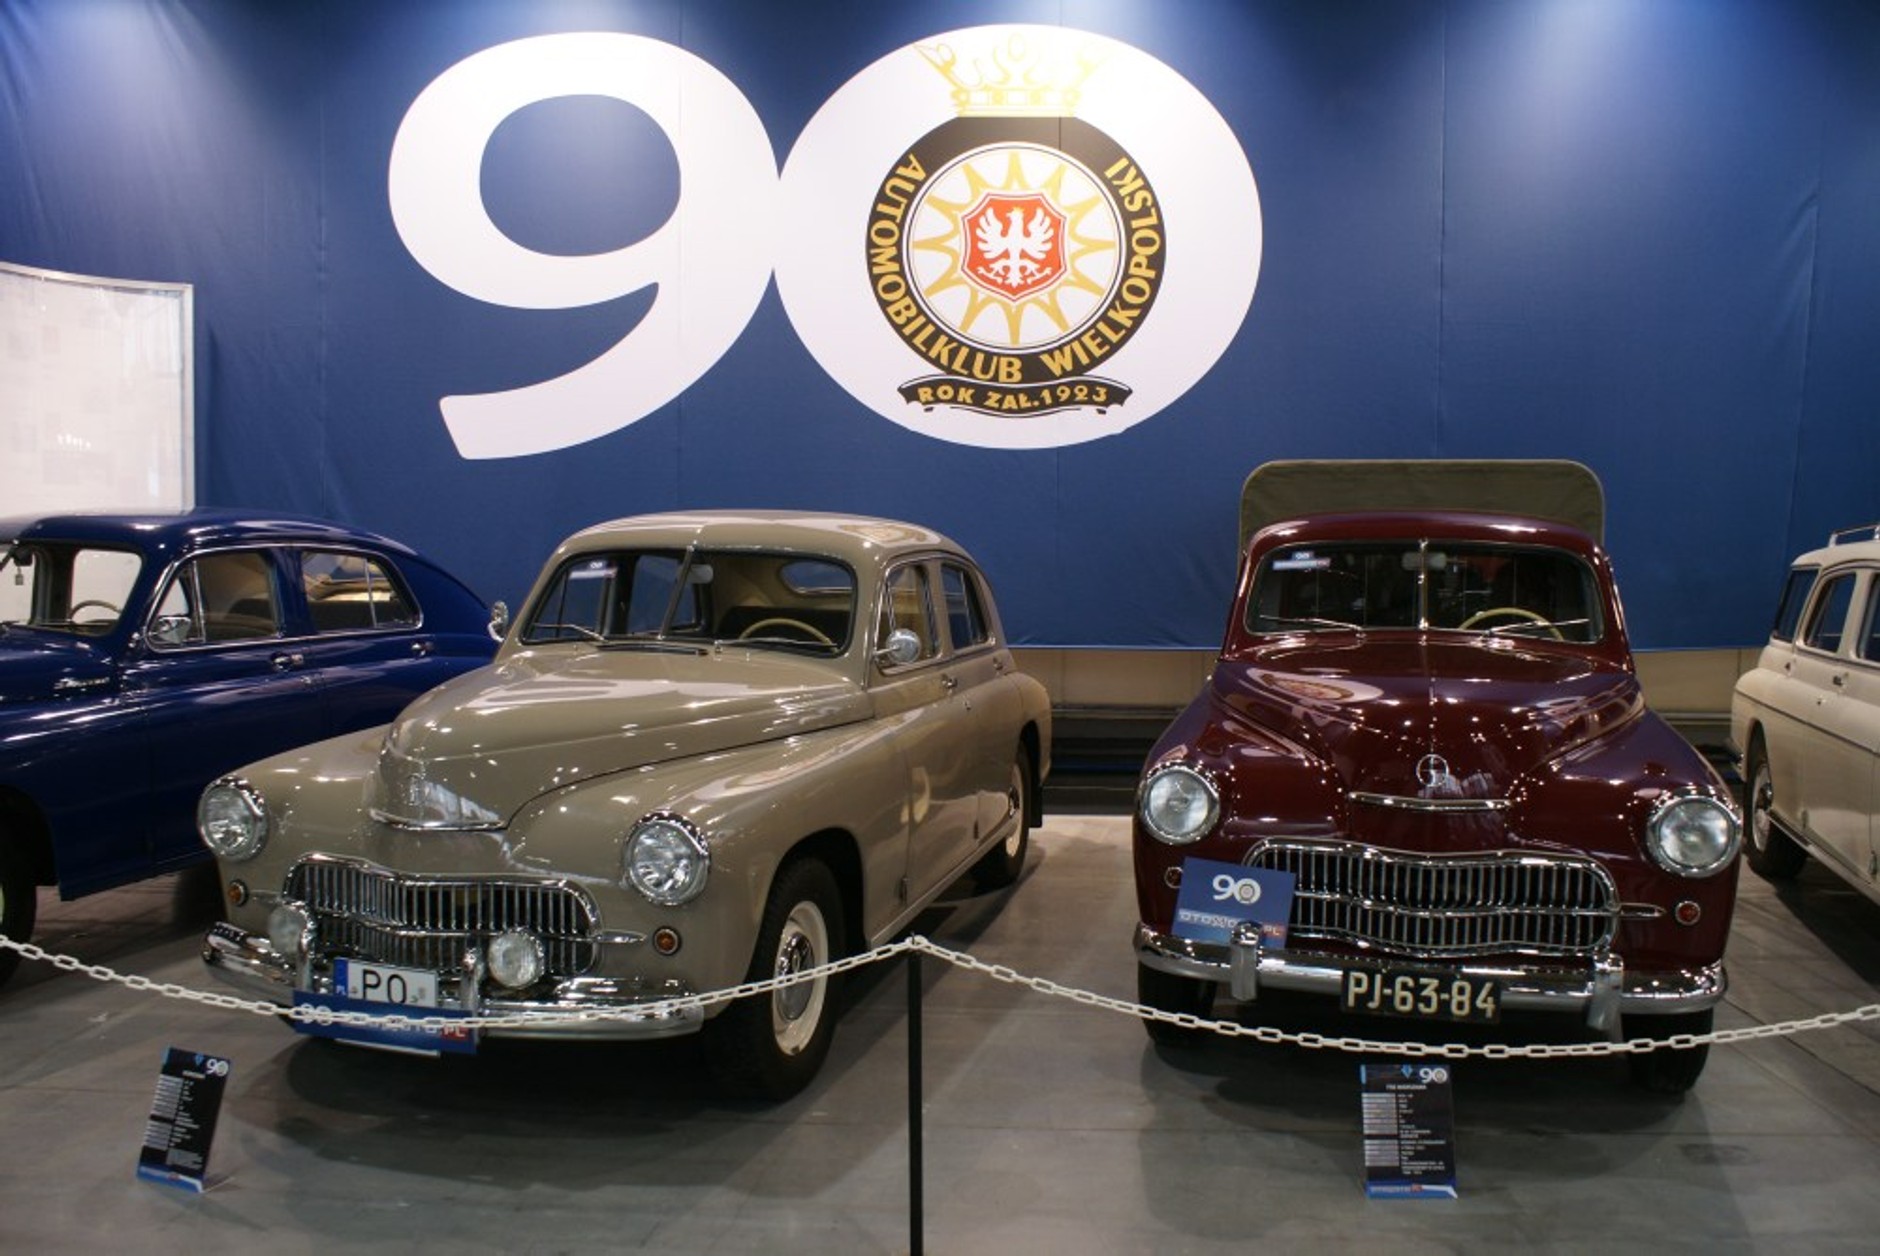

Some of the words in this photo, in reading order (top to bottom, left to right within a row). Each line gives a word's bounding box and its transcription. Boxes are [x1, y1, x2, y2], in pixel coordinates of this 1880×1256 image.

[387, 24, 1263, 460] 90
[868, 153, 1023, 384] AUTOMOBILKLUB
[1038, 156, 1162, 378] WIELKOPOLSKI
[916, 385, 974, 404] ROK
[1212, 873, 1262, 906] 90
[362, 968, 407, 1005] PO
[1347, 971, 1497, 1019] PJ-63-84
[1418, 1067, 1448, 1084] 90
